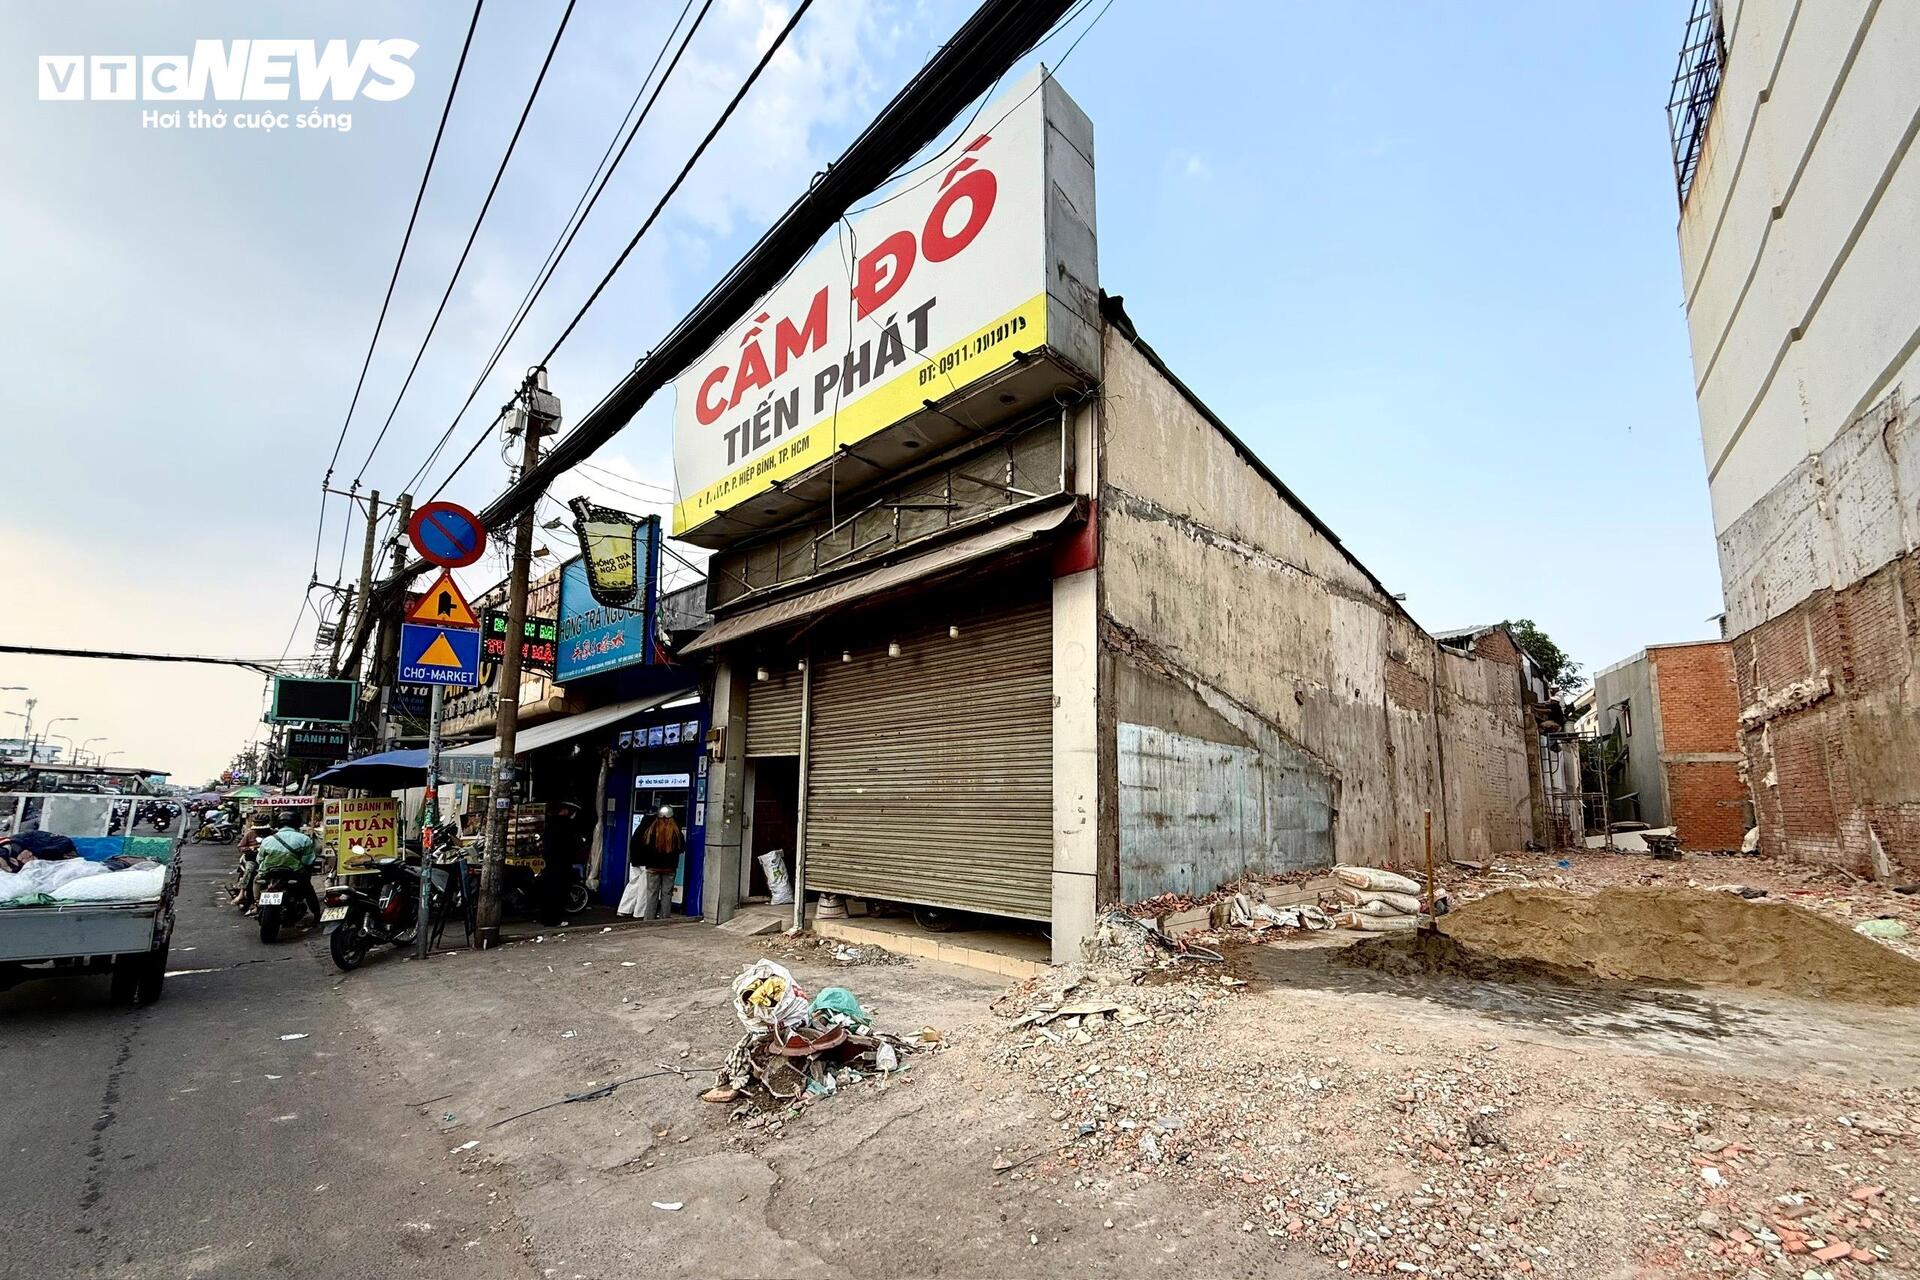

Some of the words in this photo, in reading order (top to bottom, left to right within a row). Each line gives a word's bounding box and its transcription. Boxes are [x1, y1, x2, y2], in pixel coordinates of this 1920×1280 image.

[696, 285, 828, 426] CẦM
[851, 133, 998, 322] ĐỒ
[723, 387, 799, 466] TIẾN
[814, 296, 936, 415] PHÁT
[778, 447, 789, 464] TP.
[791, 435, 810, 458] HCM
[342, 813, 395, 832] TUẤN
[347, 833, 388, 852] MẬP
